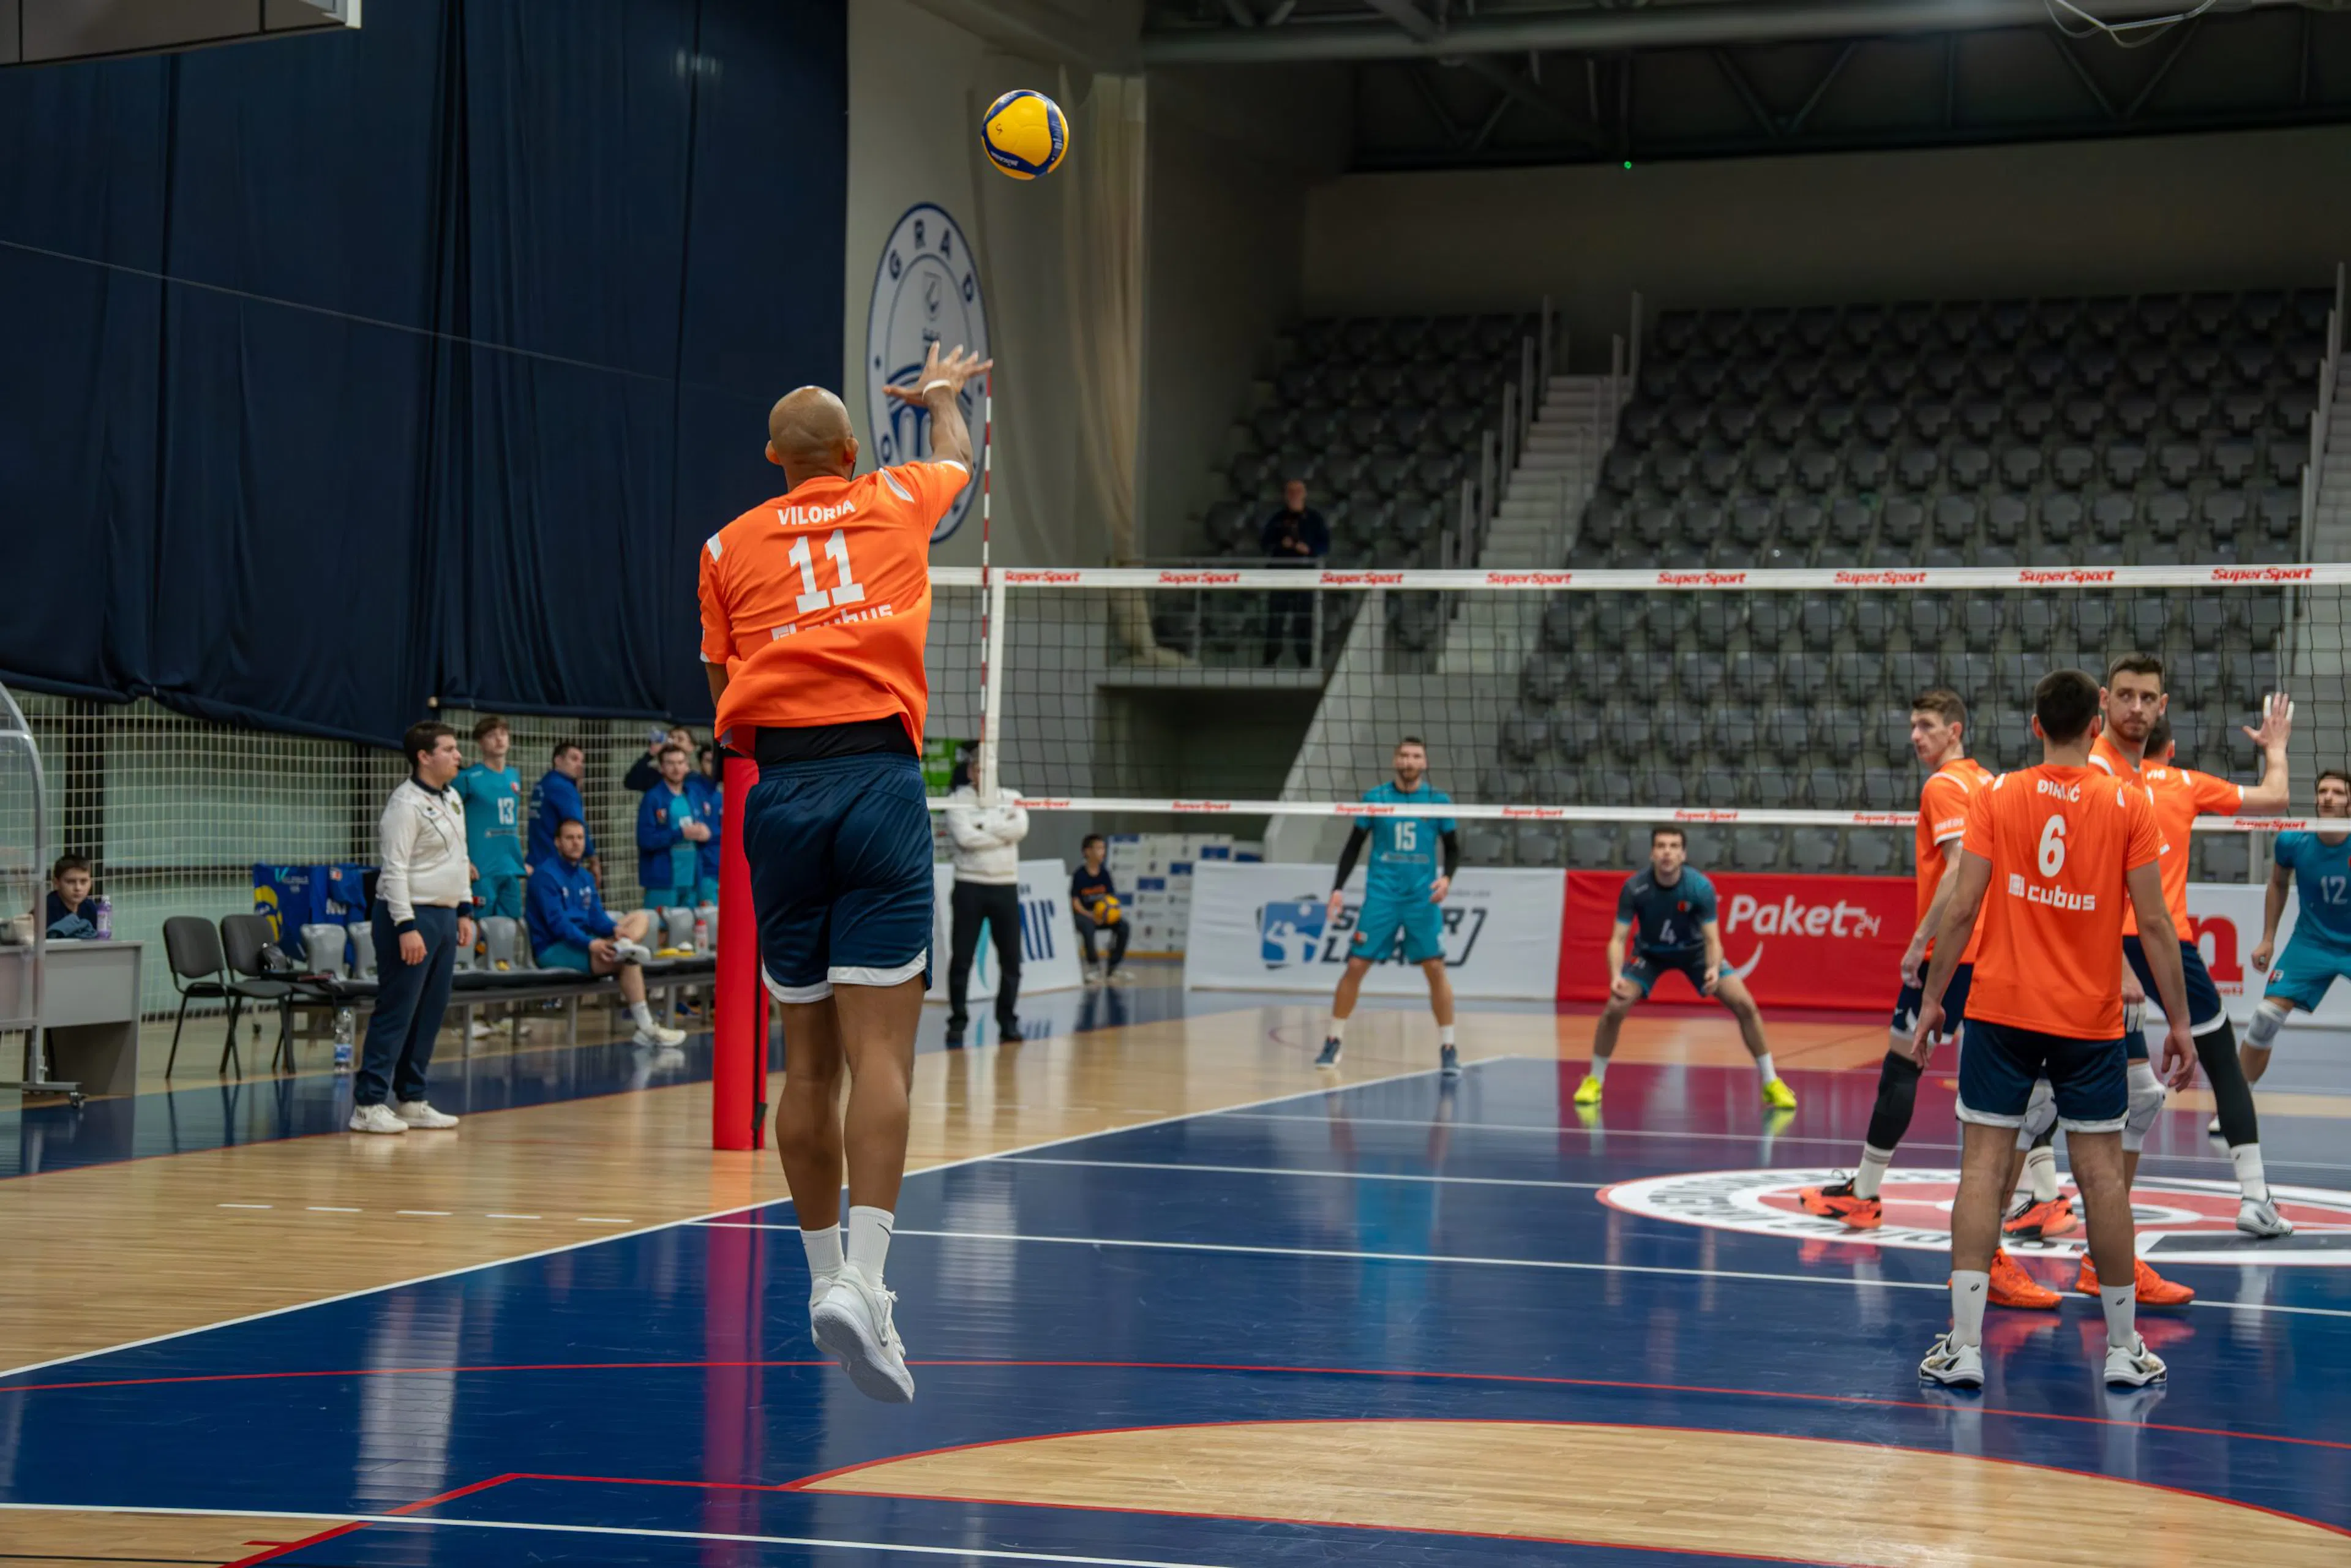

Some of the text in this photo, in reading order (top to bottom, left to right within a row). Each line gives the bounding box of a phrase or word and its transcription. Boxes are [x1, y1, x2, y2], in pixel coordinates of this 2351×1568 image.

[778, 500, 856, 525] VILORIA
[789, 529, 866, 615] 11
[497, 797, 514, 825] 13
[1395, 821, 1416, 852] 15
[2038, 814, 2066, 878] 6
[2320, 876, 2348, 905] 12
[1660, 919, 1676, 944] 4
